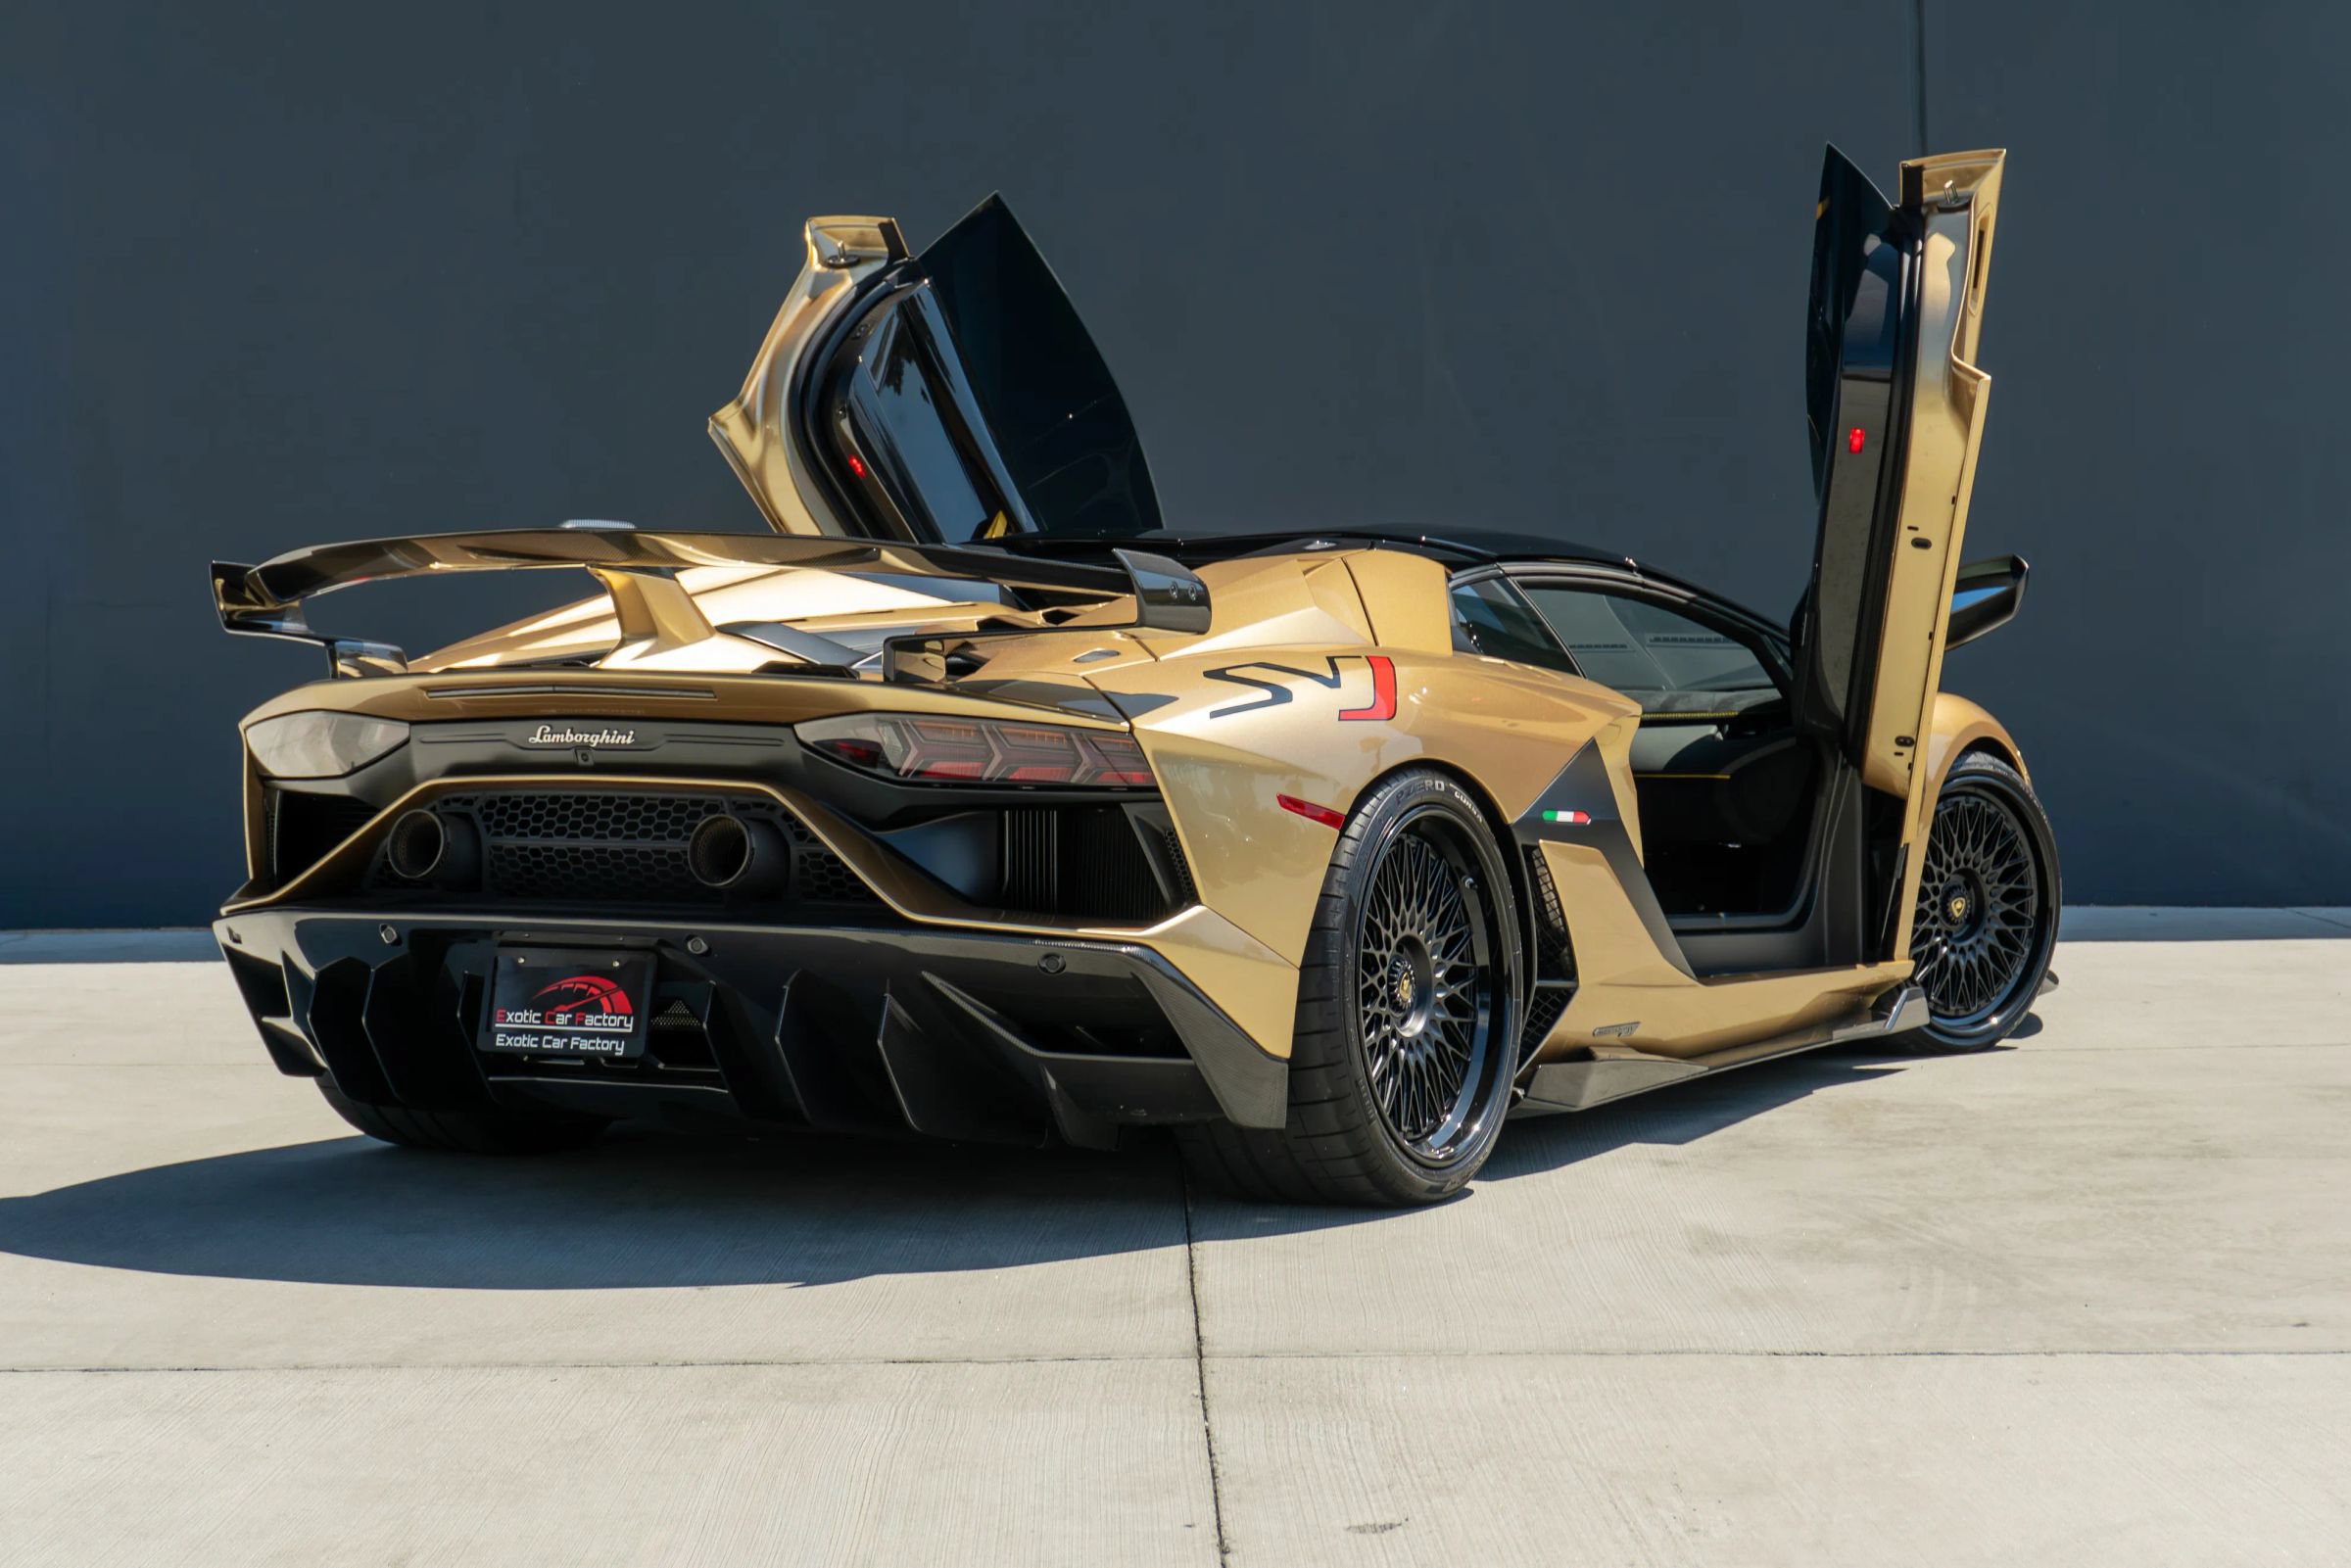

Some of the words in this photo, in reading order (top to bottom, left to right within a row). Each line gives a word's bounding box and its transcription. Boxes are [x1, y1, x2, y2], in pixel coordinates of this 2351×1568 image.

[1203, 655, 1397, 721] SVJ
[529, 725, 635, 747] Lamborghini
[496, 1009, 541, 1023] Exotic
[545, 1011, 571, 1025] Car
[575, 1013, 634, 1031] Factory
[496, 1034, 539, 1048] Exotic
[543, 1035, 567, 1049] Car
[570, 1037, 624, 1056] Factory
